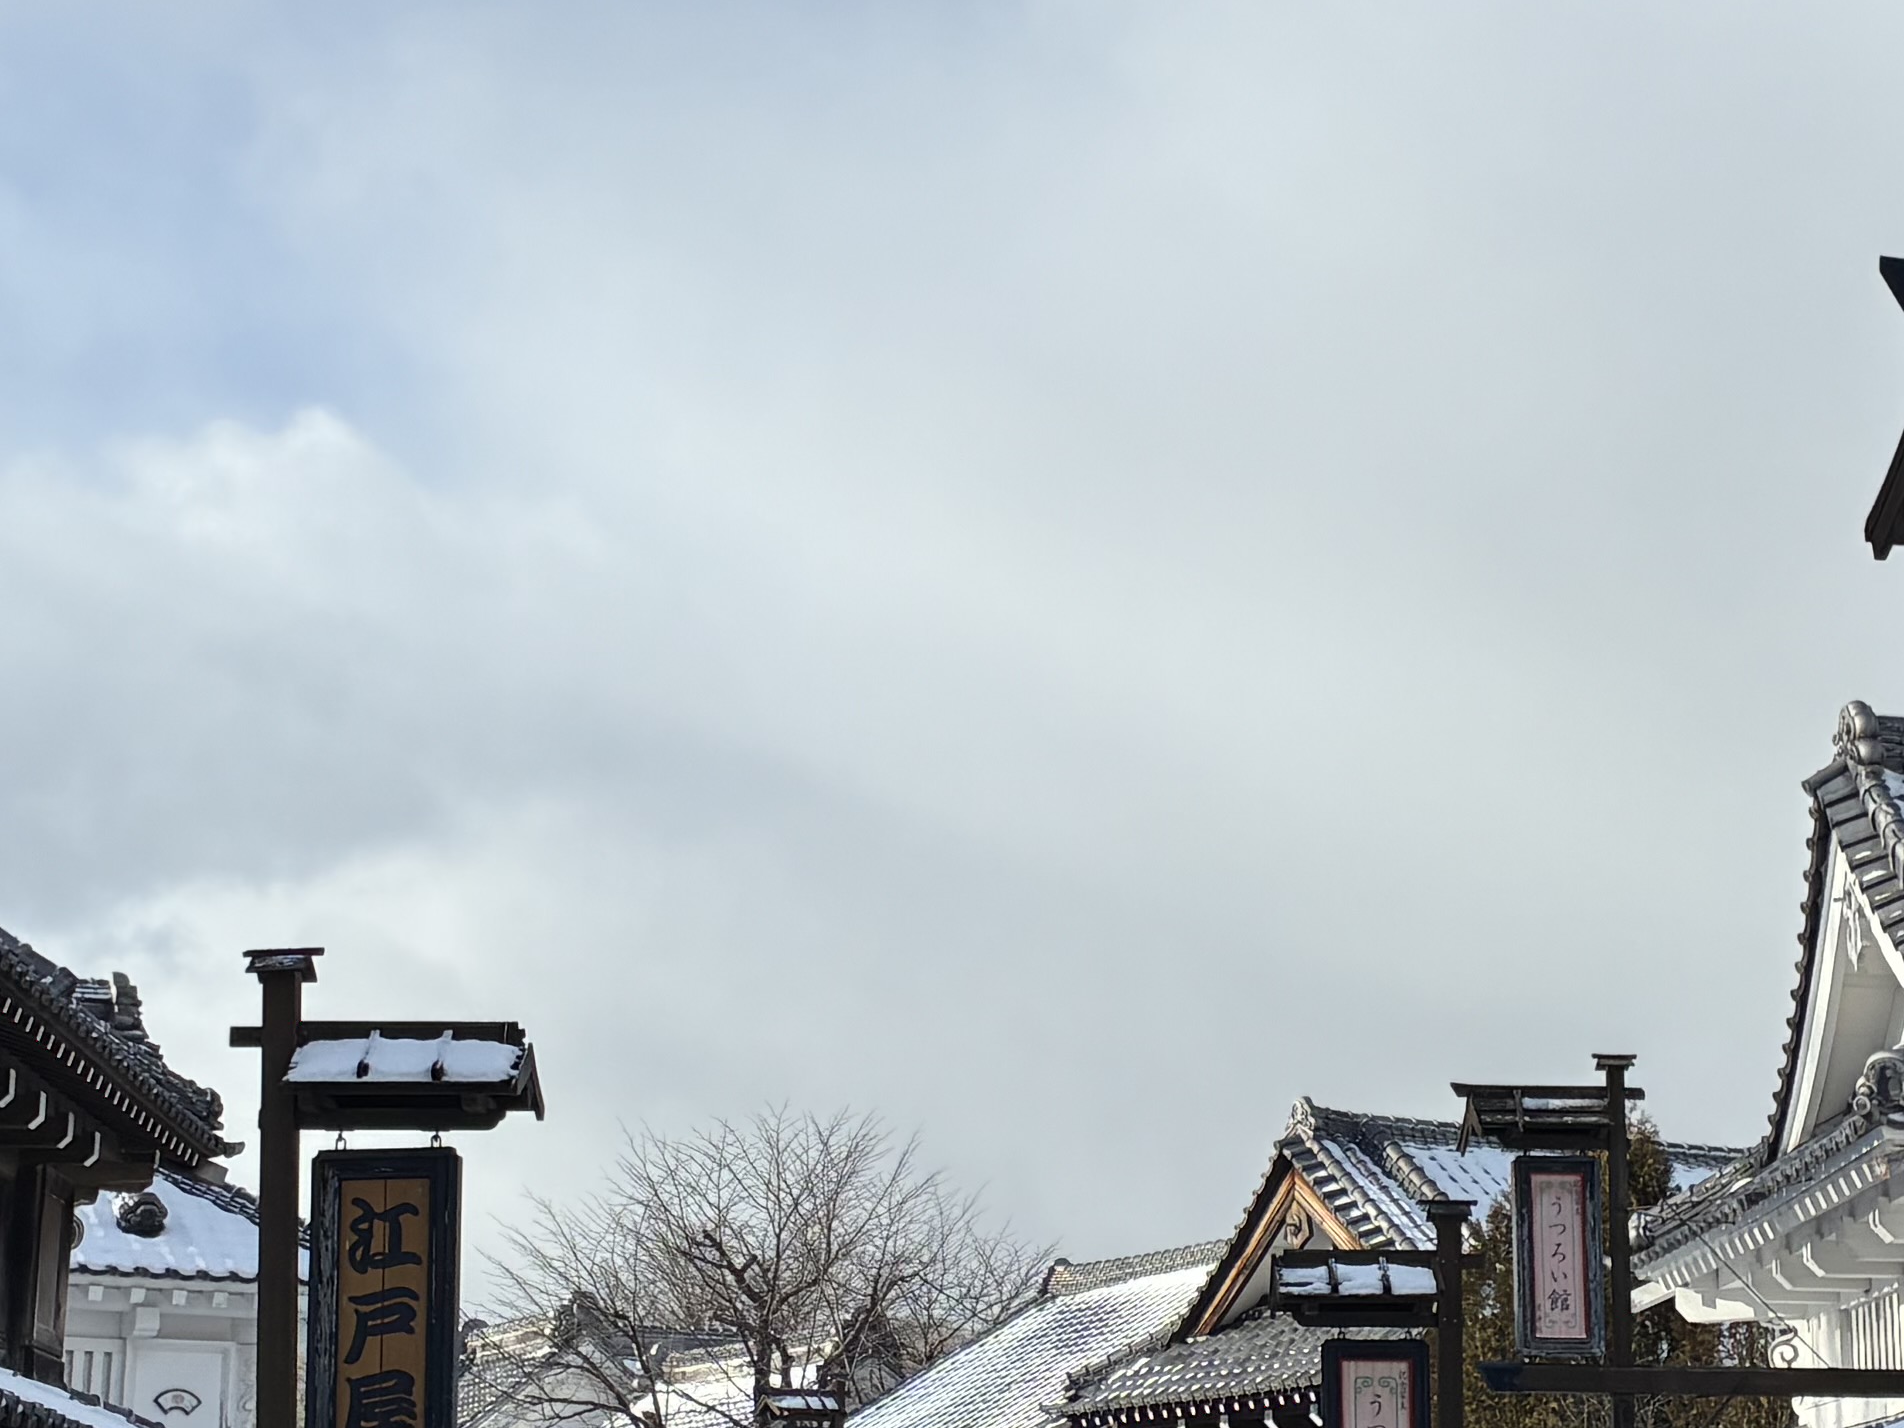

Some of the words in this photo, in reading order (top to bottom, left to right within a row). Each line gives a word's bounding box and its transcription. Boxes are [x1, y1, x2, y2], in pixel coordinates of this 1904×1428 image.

[1547, 1196, 1573, 1313] うつろい館
